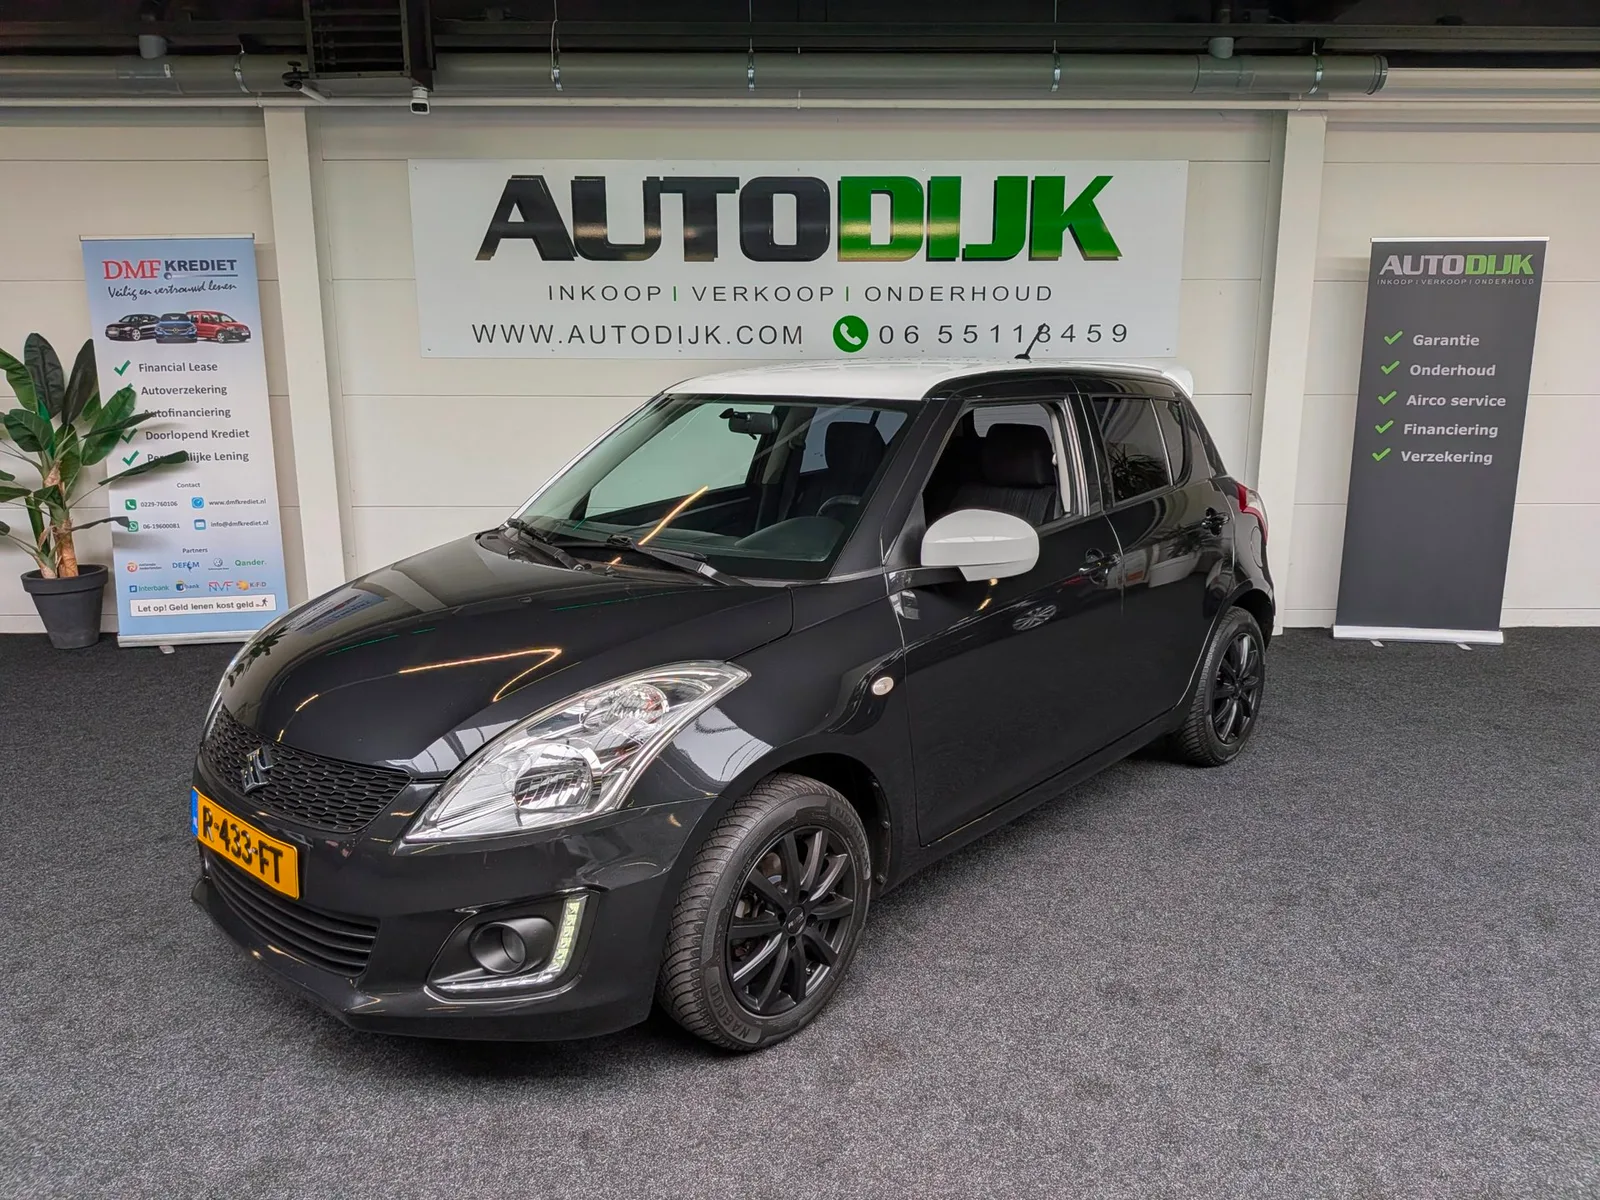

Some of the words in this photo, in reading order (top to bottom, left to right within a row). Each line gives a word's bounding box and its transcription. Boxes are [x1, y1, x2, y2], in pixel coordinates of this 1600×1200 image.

[475, 175, 1123, 262] AUTODIJK
[102, 259, 161, 280] DMF
[164, 259, 238, 272] KREDIET
[1379, 254, 1534, 276] AUTODIJK
[108, 286, 138, 301] Veilig
[139, 287, 152, 295] en
[154, 281, 206, 295] vertrouwd
[208, 280, 238, 292] lenen
[548, 285, 661, 301] INKOOP
[692, 285, 834, 302] VERKOOP
[864, 285, 1053, 302] ONDERHOUD
[472, 324, 803, 345] WWW.AUTODIJK.COM
[879, 325, 920, 344] 06
[937, 323, 1128, 344] 55118459
[1413, 334, 1480, 346] Garantie
[138, 362, 186, 373] Financial
[189, 362, 218, 372] Lease
[1410, 364, 1496, 376] Onderhoud
[141, 384, 228, 396] Autoverzekering
[1406, 394, 1446, 406] Airco
[1450, 394, 1507, 407] service
[145, 430, 209, 441] Doorlopend
[211, 429, 250, 439] Krediet
[1403, 423, 1499, 438] Financiering
[147, 452, 212, 464] Pelijke
[214, 452, 250, 463] Lening
[1400, 451, 1494, 466] Verzekering
[176, 481, 201, 489] Contact
[140, 500, 179, 508] 0229-760106
[208, 498, 267, 506] www.dmfkrediet.nl
[210, 520, 269, 528] info@dmfkrediet.nl
[138, 584, 169, 592] Interbank
[137, 604, 152, 613] Let
[153, 604, 168, 613] op!
[168, 603, 189, 612] Geld
[190, 602, 214, 611] lenen
[216, 601, 235, 610] kost
[236, 600, 254, 610] geld
[202, 805, 284, 884] R-433-FT
